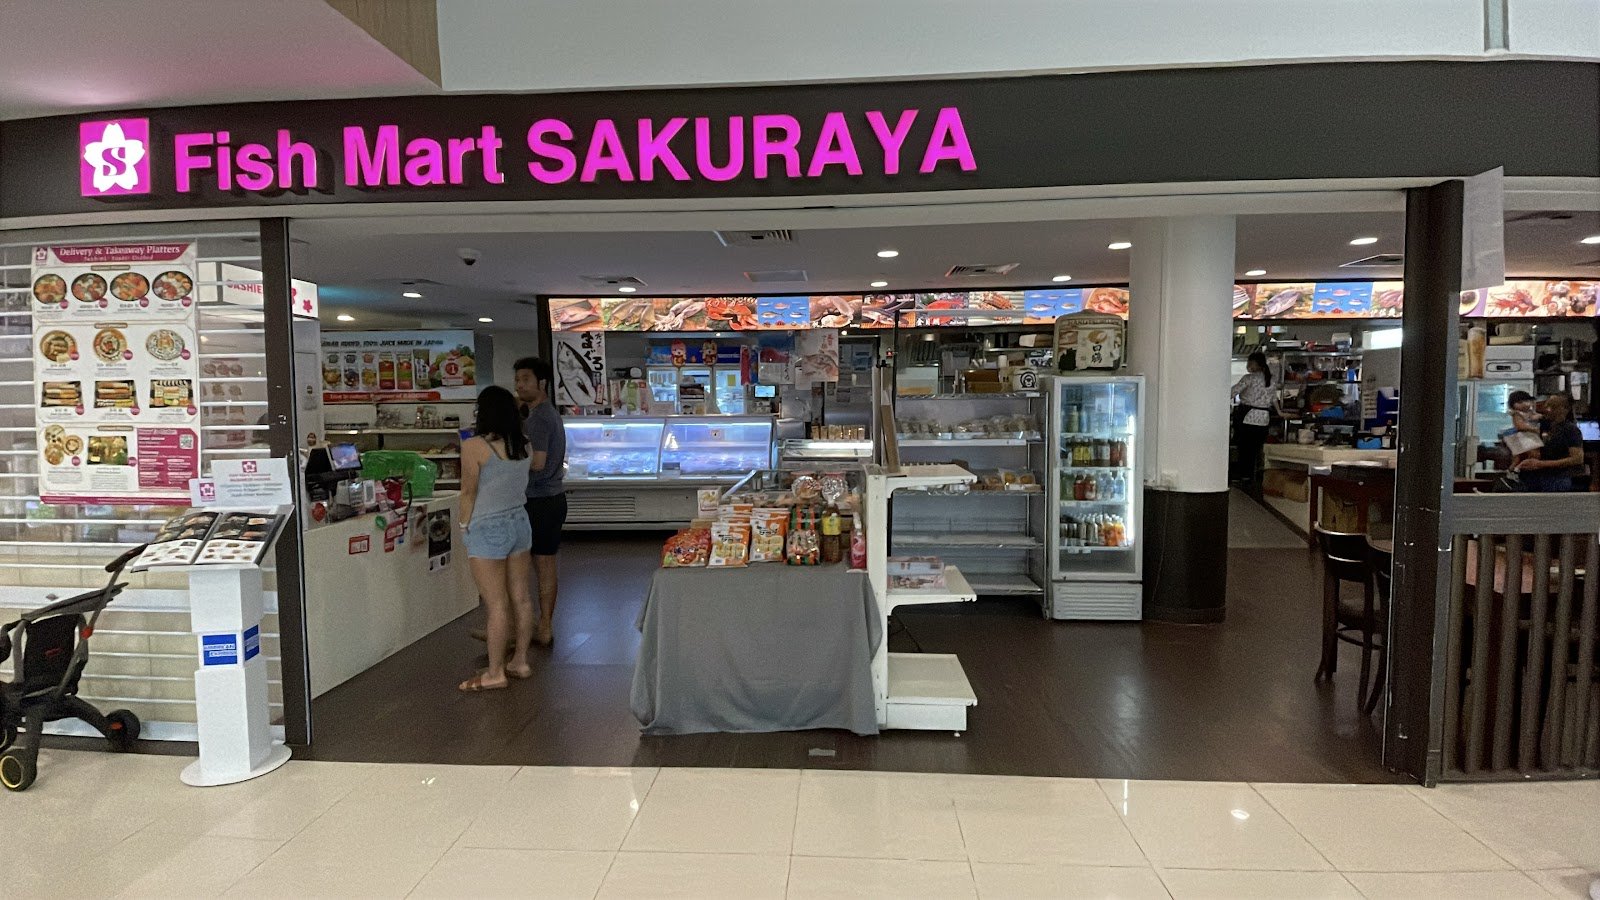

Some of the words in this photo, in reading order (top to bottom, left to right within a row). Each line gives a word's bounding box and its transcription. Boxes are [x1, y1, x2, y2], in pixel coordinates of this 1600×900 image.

[101, 147, 127, 176] S
[175, 130, 315, 192] Fish
[344, 125, 502, 185] Mart
[528, 108, 976, 183] SAKURAYA
[60, 247, 93, 257] Delivery
[95, 247, 102, 255] &
[105, 246, 145, 256] Takeaway
[146, 245, 180, 254] Platters
[581, 331, 604, 370] まぐろ
